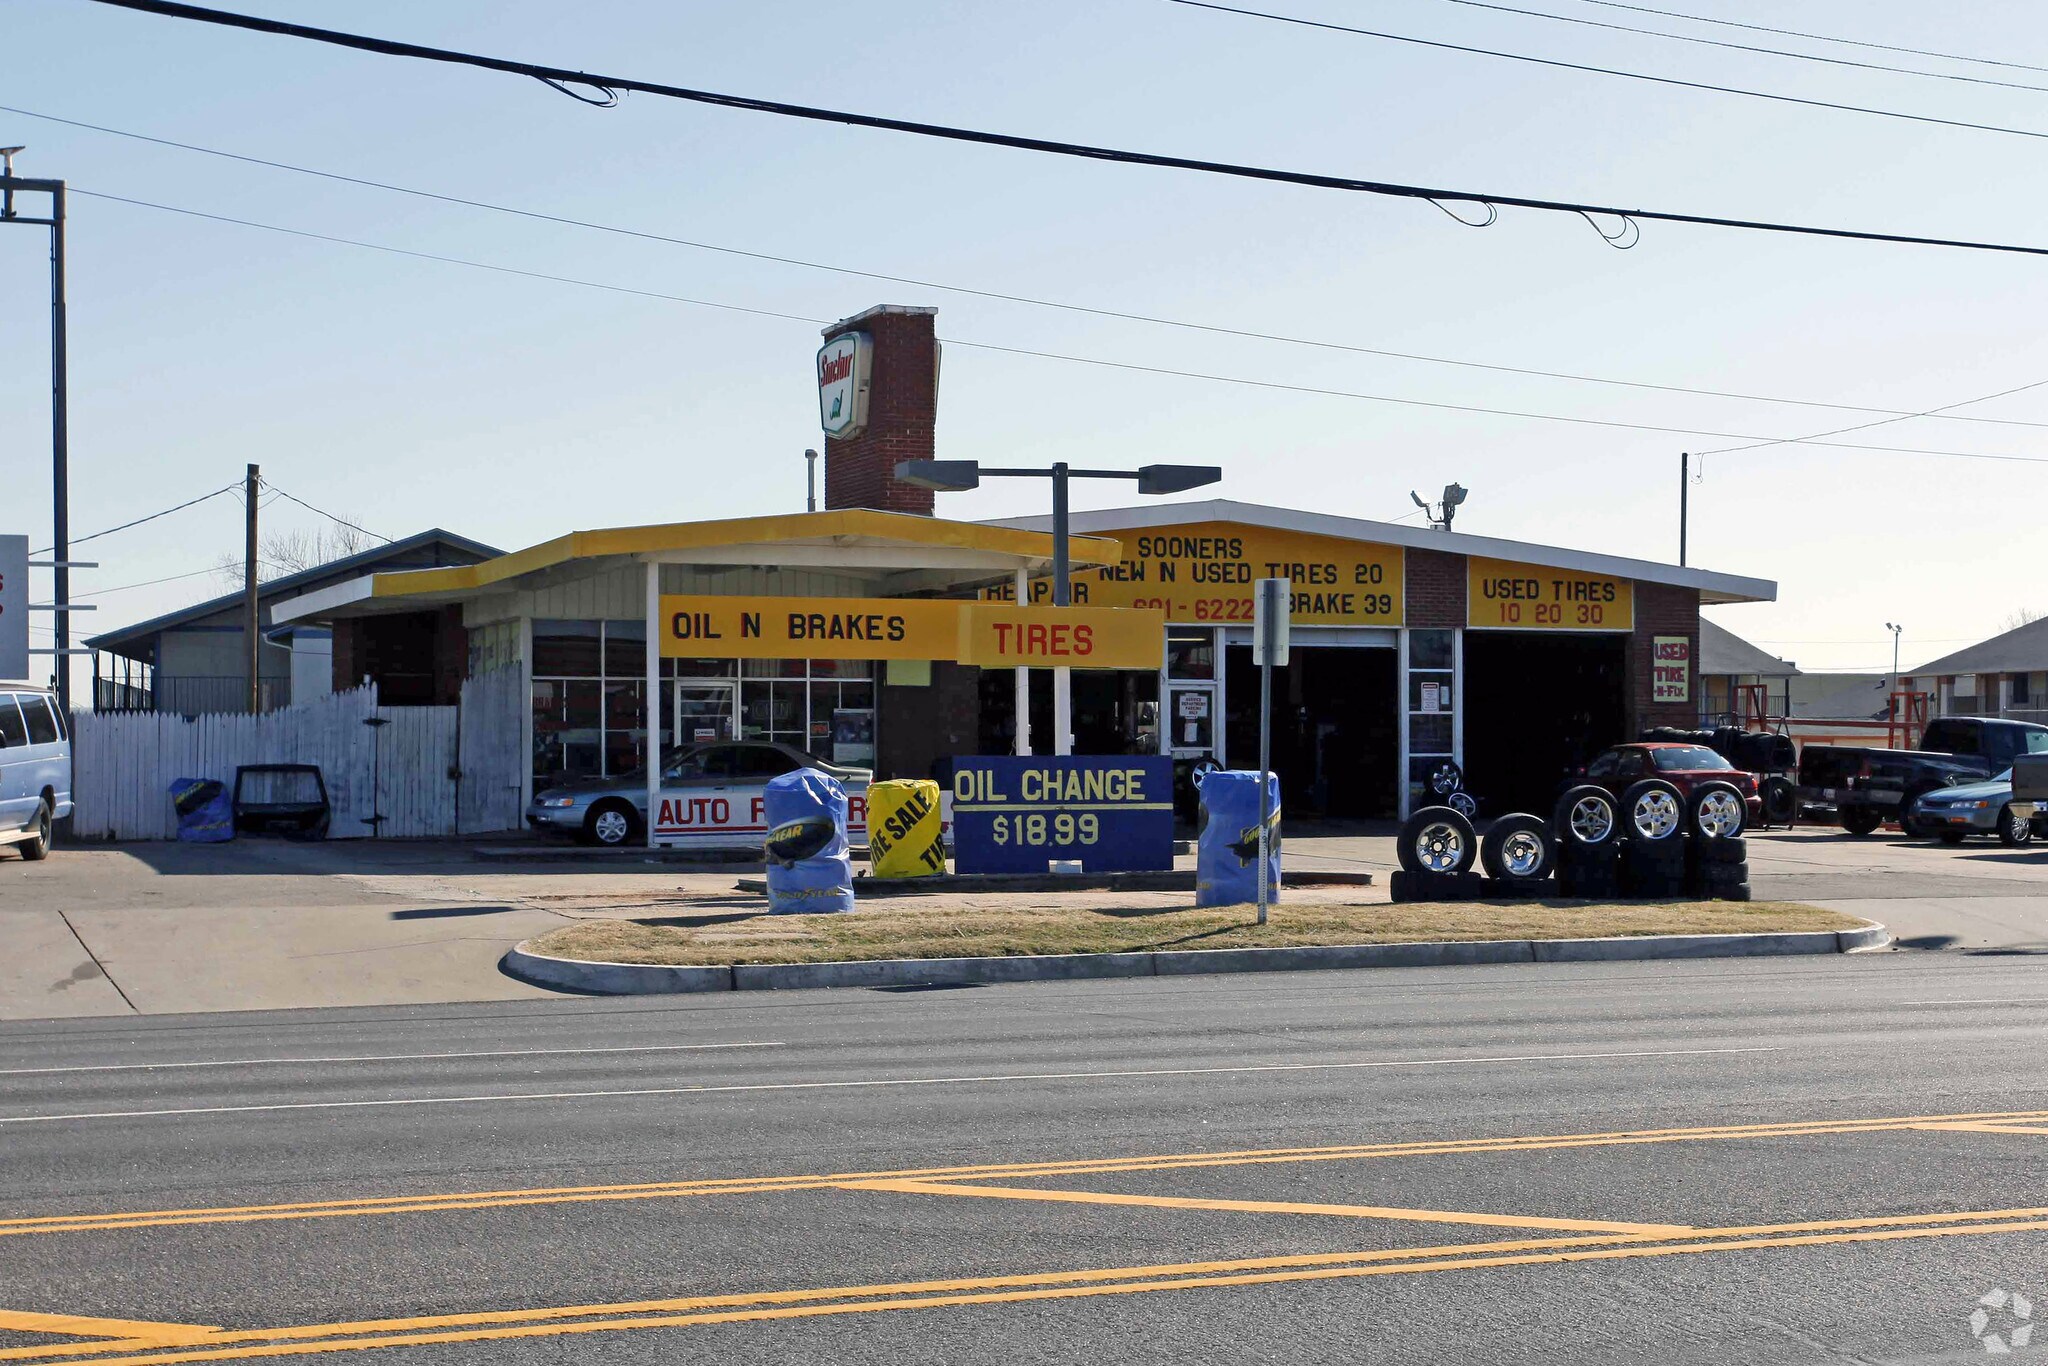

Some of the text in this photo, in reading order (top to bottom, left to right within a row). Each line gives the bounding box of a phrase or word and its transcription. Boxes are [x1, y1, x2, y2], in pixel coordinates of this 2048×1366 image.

[1138, 536, 1242, 559] SOONERS
[1099, 561, 1383, 585] NEW N USED TIRES 20
[1483, 578, 1615, 602] USED TIRES
[1364, 594, 1391, 614] 39
[1500, 603, 1603, 624] 10 20 30
[672, 612, 905, 641] OIL N BRAKES
[992, 623, 1093, 656] TIRES
[1655, 643, 1689, 660] USED
[954, 769, 1146, 801] OIL CHANGE
[658, 797, 729, 825] AUTO
[885, 790, 932, 840] SALE
[993, 814, 1099, 847] $18.99
